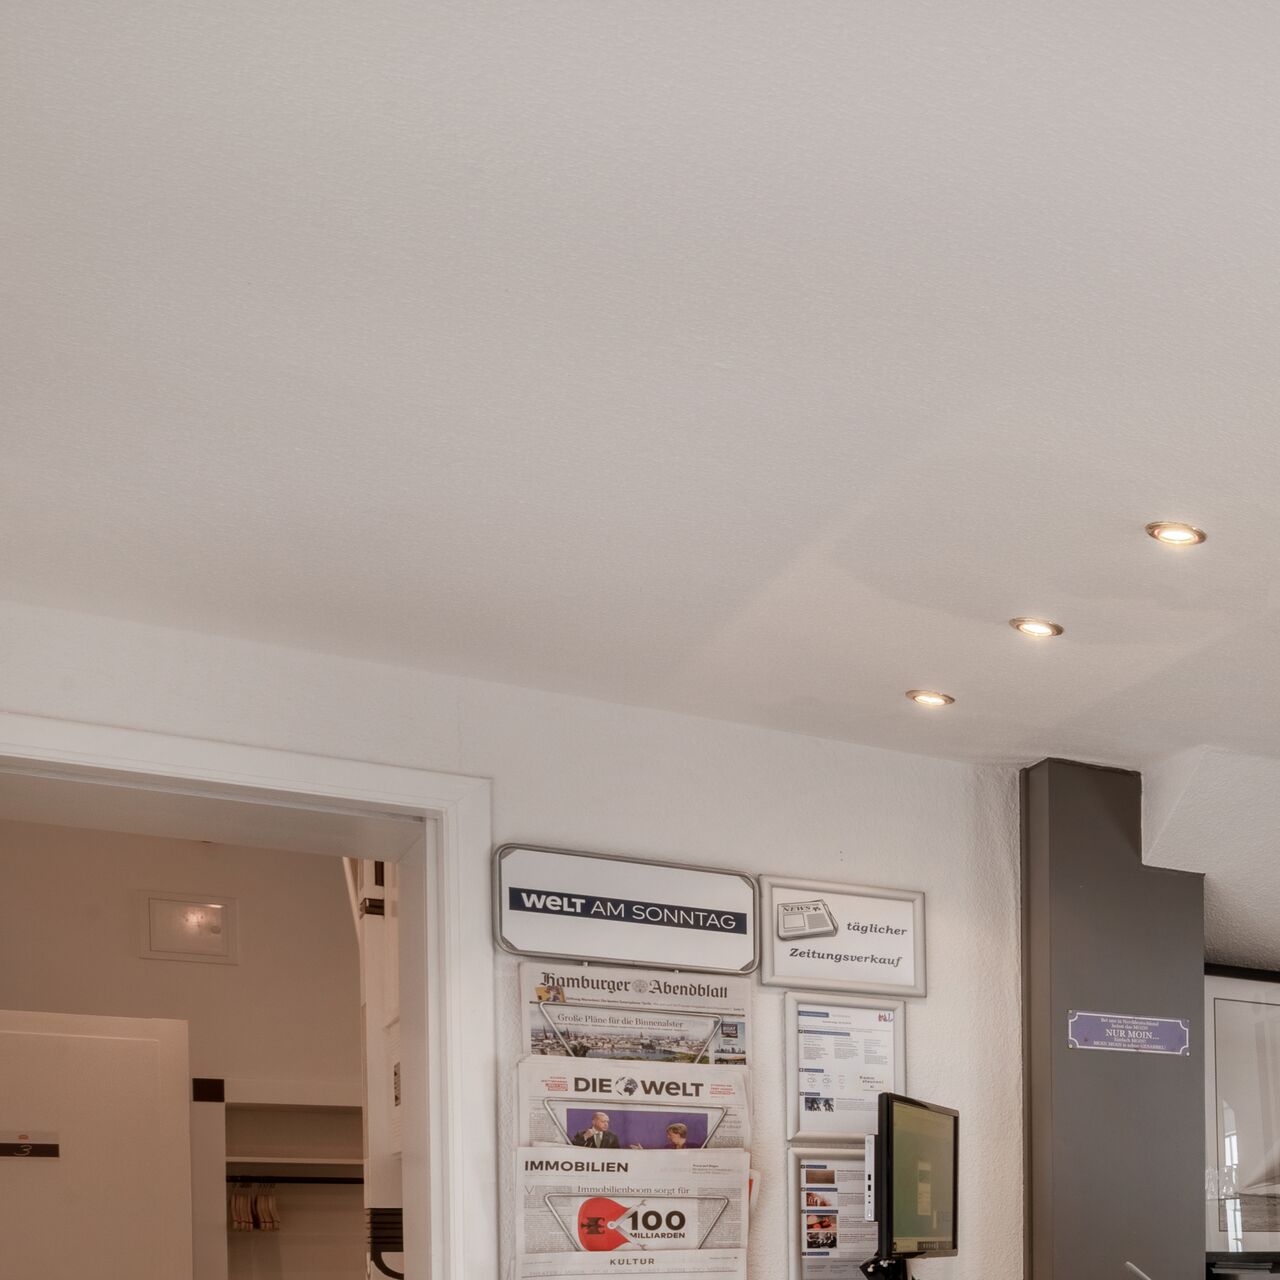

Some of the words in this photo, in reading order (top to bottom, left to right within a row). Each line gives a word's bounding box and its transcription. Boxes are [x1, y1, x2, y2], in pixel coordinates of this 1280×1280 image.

[590, 900, 625, 918] AM
[632, 905, 736, 929] SONNTAG
[847, 921, 907, 935] täglicher
[789, 948, 902, 967] Zeitungsverkauf
[540, 971, 631, 994] Hamburger
[648, 979, 728, 998] Abendblatt
[557, 1013, 583, 1023] Große
[608, 1015, 619, 1025] für
[620, 1016, 633, 1025] die
[1105, 1028, 1126, 1038] NUR
[574, 1077, 612, 1093] DIE
[524, 1160, 629, 1173] IMMOBILIEN
[577, 1185, 652, 1194] Immobilienboom
[653, 1187, 676, 1195] sorgt
[677, 1187, 690, 1195] für
[627, 1210, 686, 1231] 100
[609, 1257, 655, 1266] KULTUR
